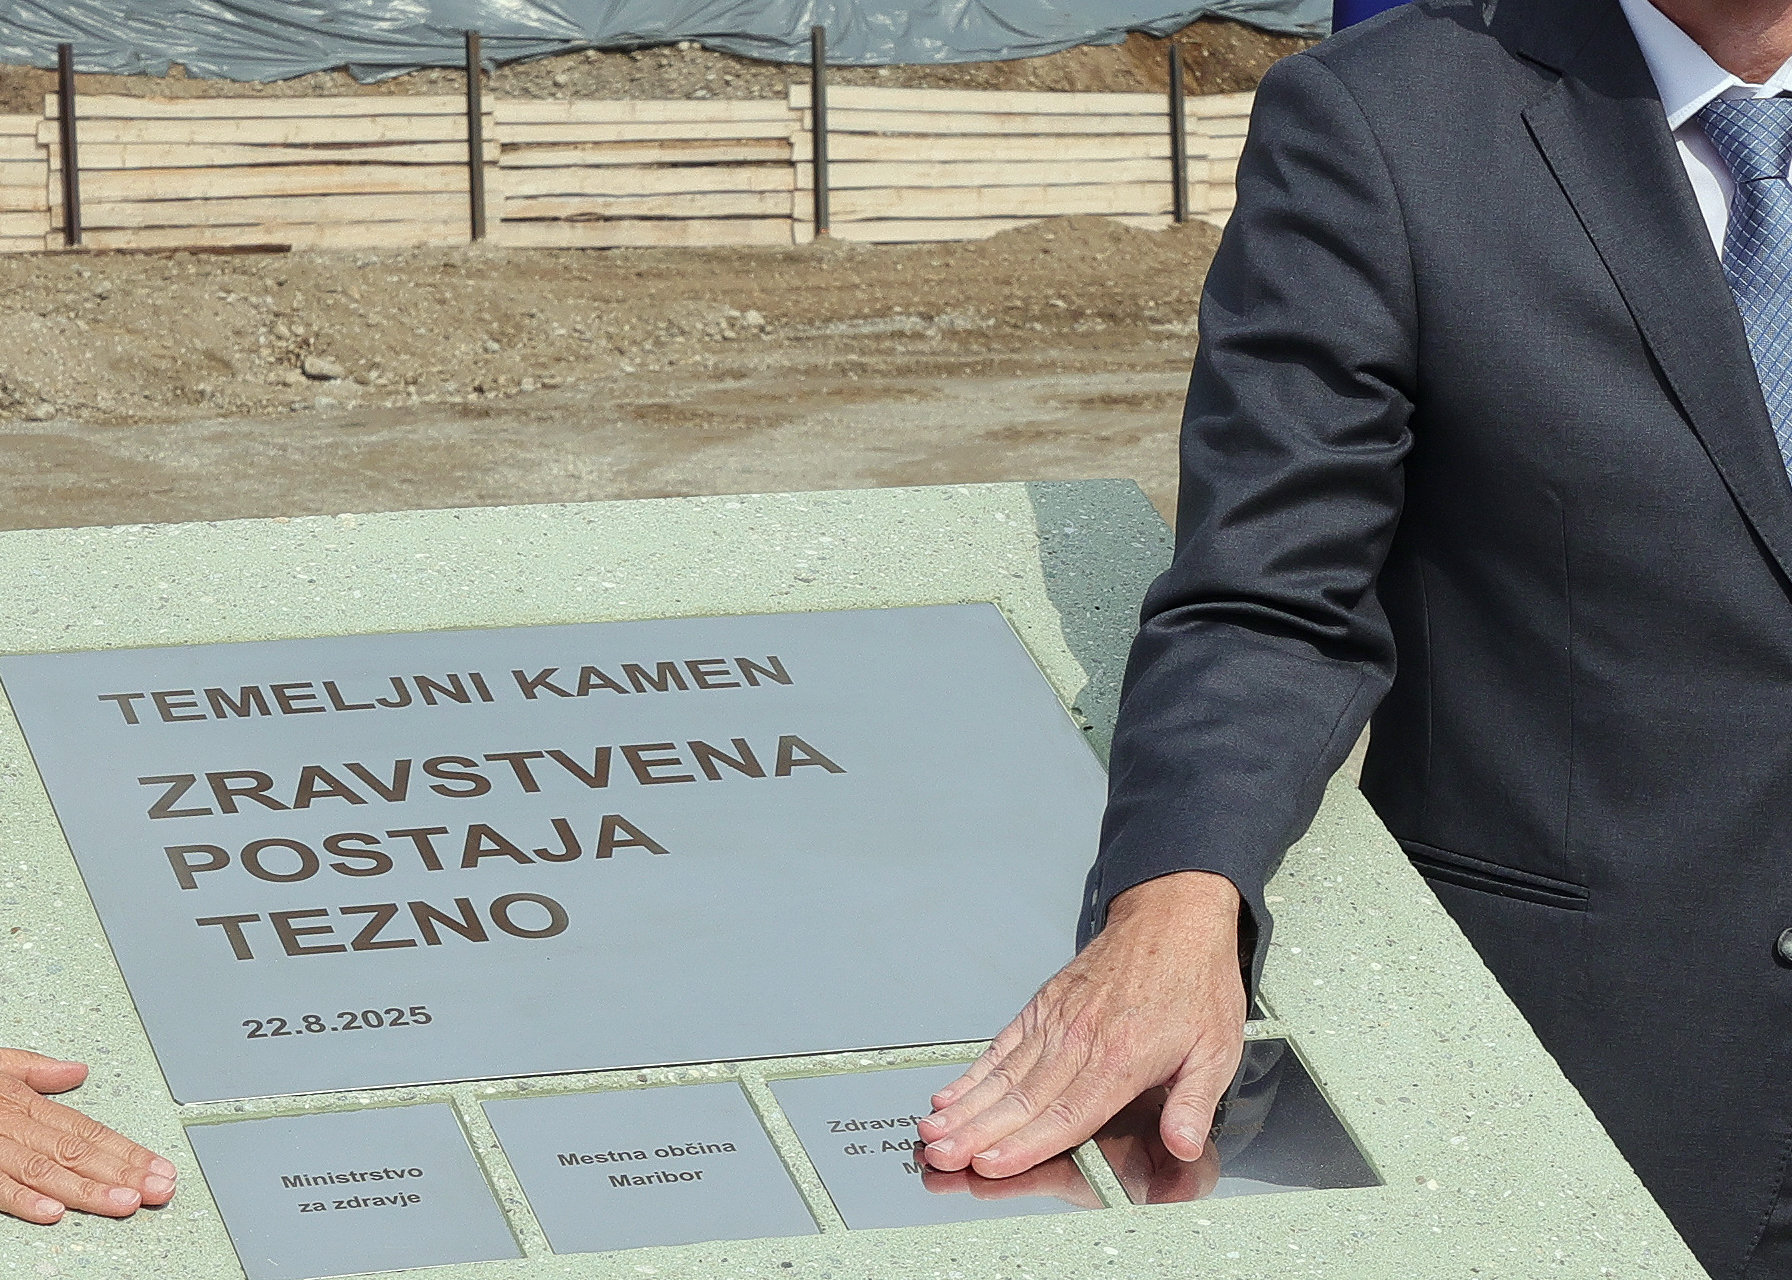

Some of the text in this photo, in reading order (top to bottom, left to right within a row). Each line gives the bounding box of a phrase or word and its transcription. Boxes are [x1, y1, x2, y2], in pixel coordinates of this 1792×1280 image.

[97, 654, 795, 725] TEMELJNI KAMEN
[137, 734, 848, 820] ZRAVSTVENA
[163, 813, 671, 890] POSTAJA
[195, 892, 570, 961] TEZNO
[241, 1005, 434, 1040] 22.8.2025
[826, 1114, 923, 1134] Zdravst
[556, 1139, 738, 1168] Mestna občina
[843, 1142, 875, 1156] dr.
[280, 1164, 425, 1190] Ministrstvo
[607, 1166, 705, 1189] Maribor
[297, 1190, 422, 1214] za zdravje
